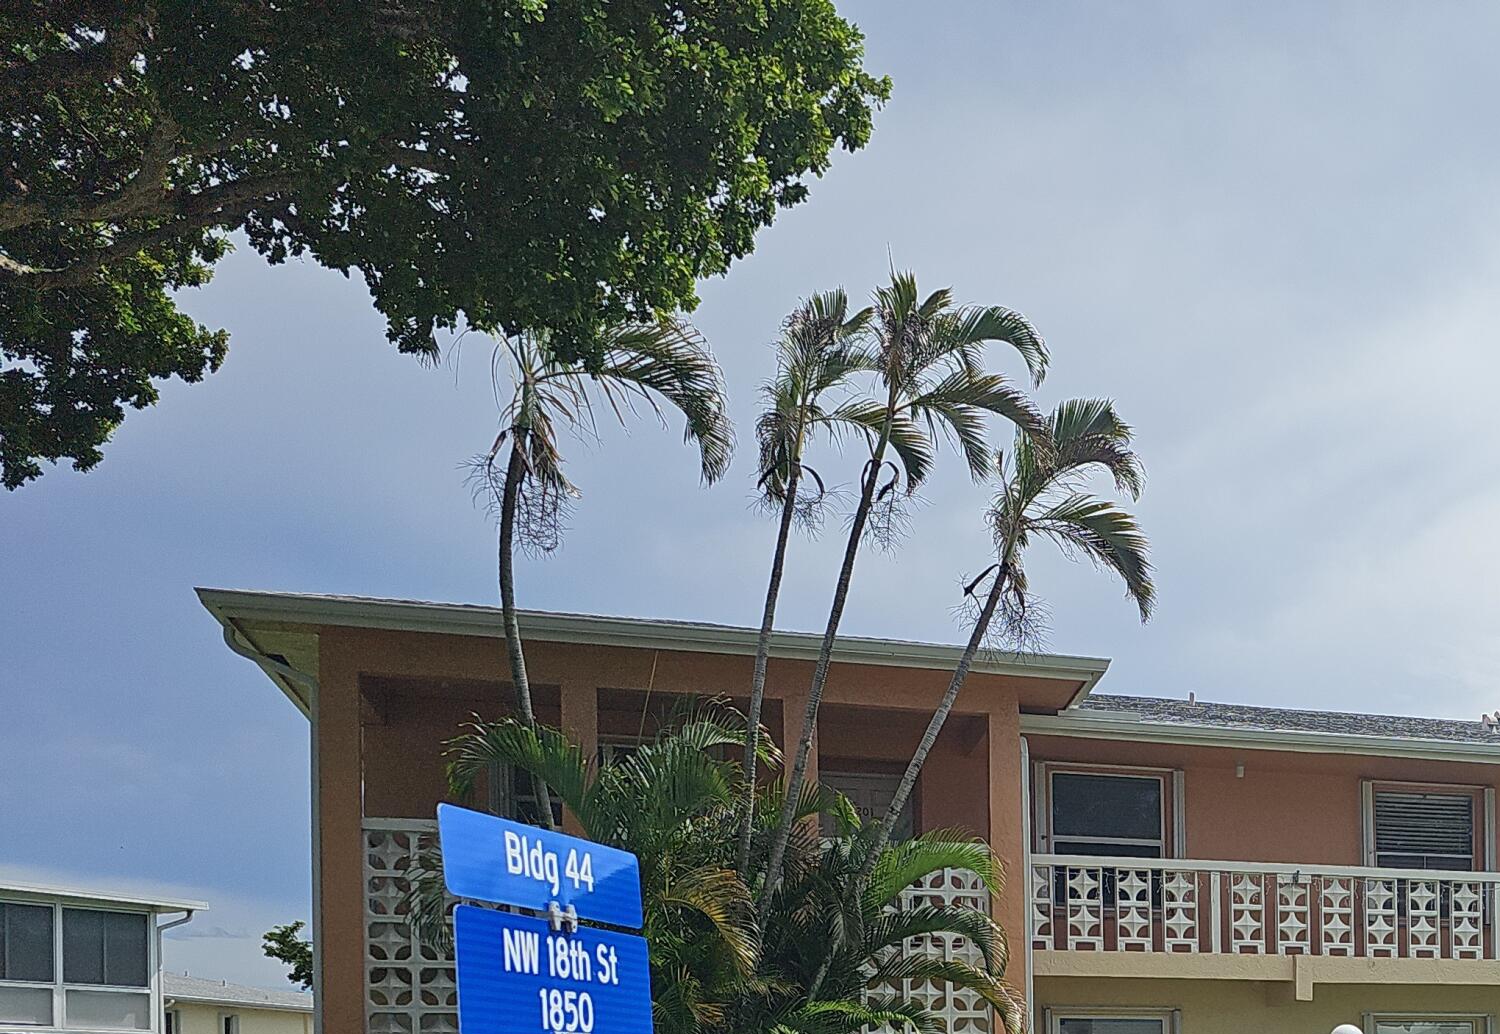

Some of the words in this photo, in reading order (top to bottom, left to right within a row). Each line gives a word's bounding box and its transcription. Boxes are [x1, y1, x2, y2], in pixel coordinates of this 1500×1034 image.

[503, 830, 560, 896] Bldg
[565, 848, 594, 893] 44
[503, 928, 539, 975] NW
[546, 936, 592, 982] 18th
[596, 943, 619, 985] St
[539, 987, 595, 1033] 1850
